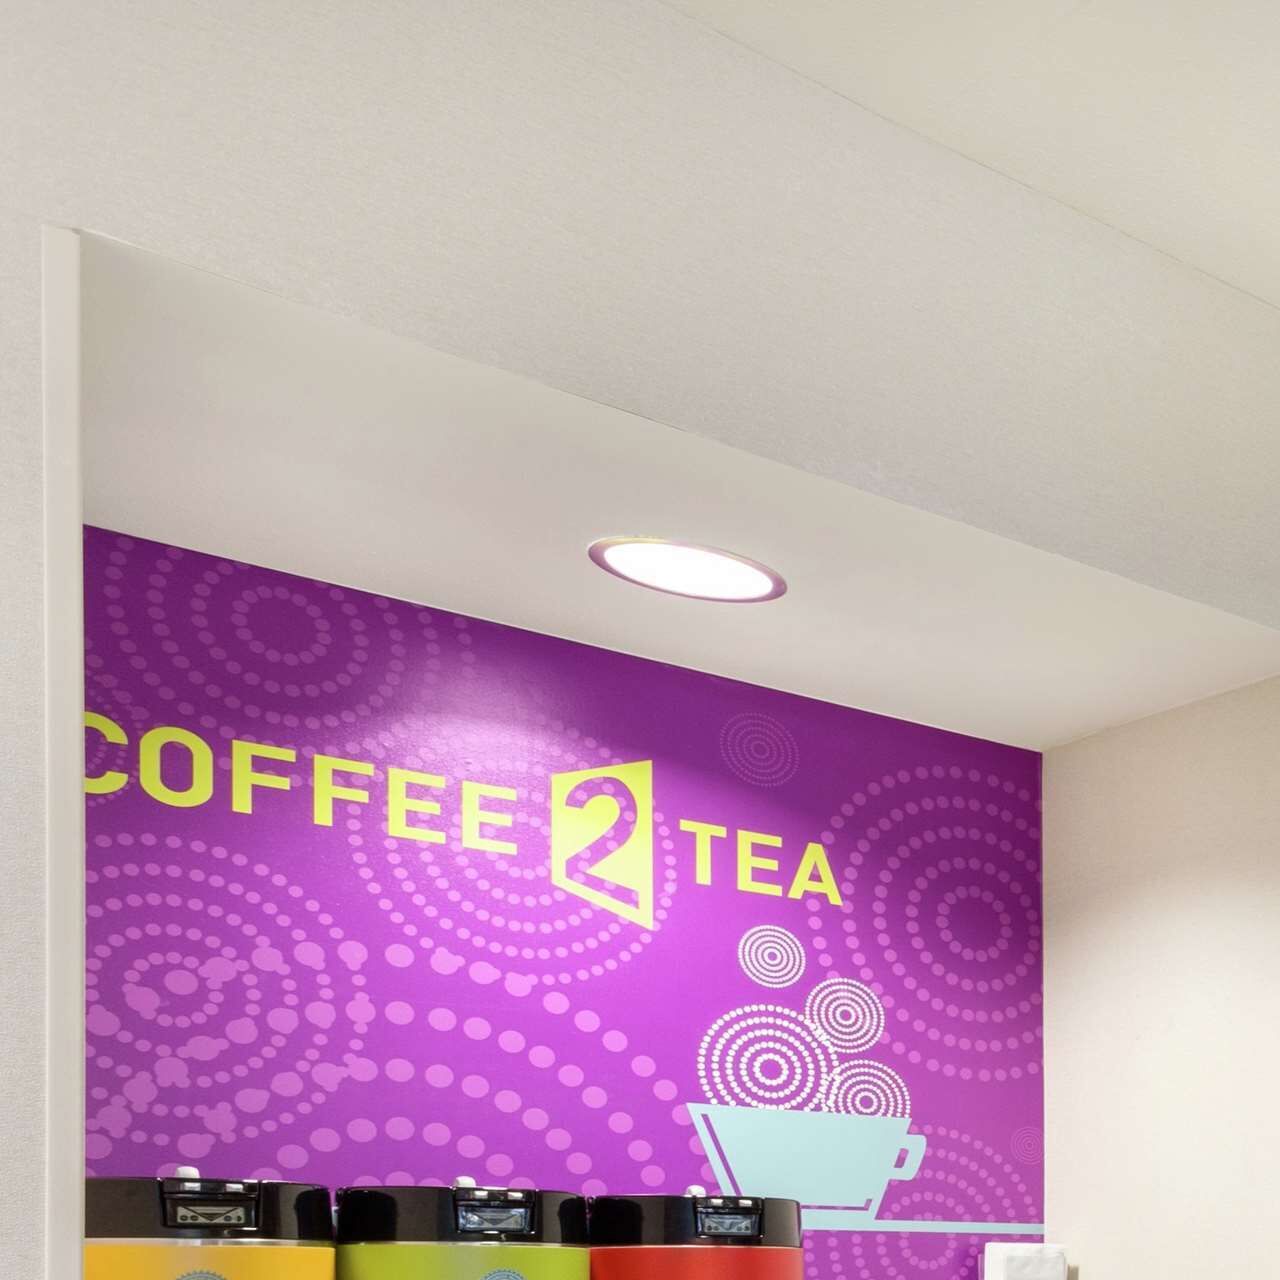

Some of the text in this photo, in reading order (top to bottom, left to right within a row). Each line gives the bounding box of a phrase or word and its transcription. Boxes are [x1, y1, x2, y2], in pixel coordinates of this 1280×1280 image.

[83, 711, 844, 906] COFFEE 2 TEA
